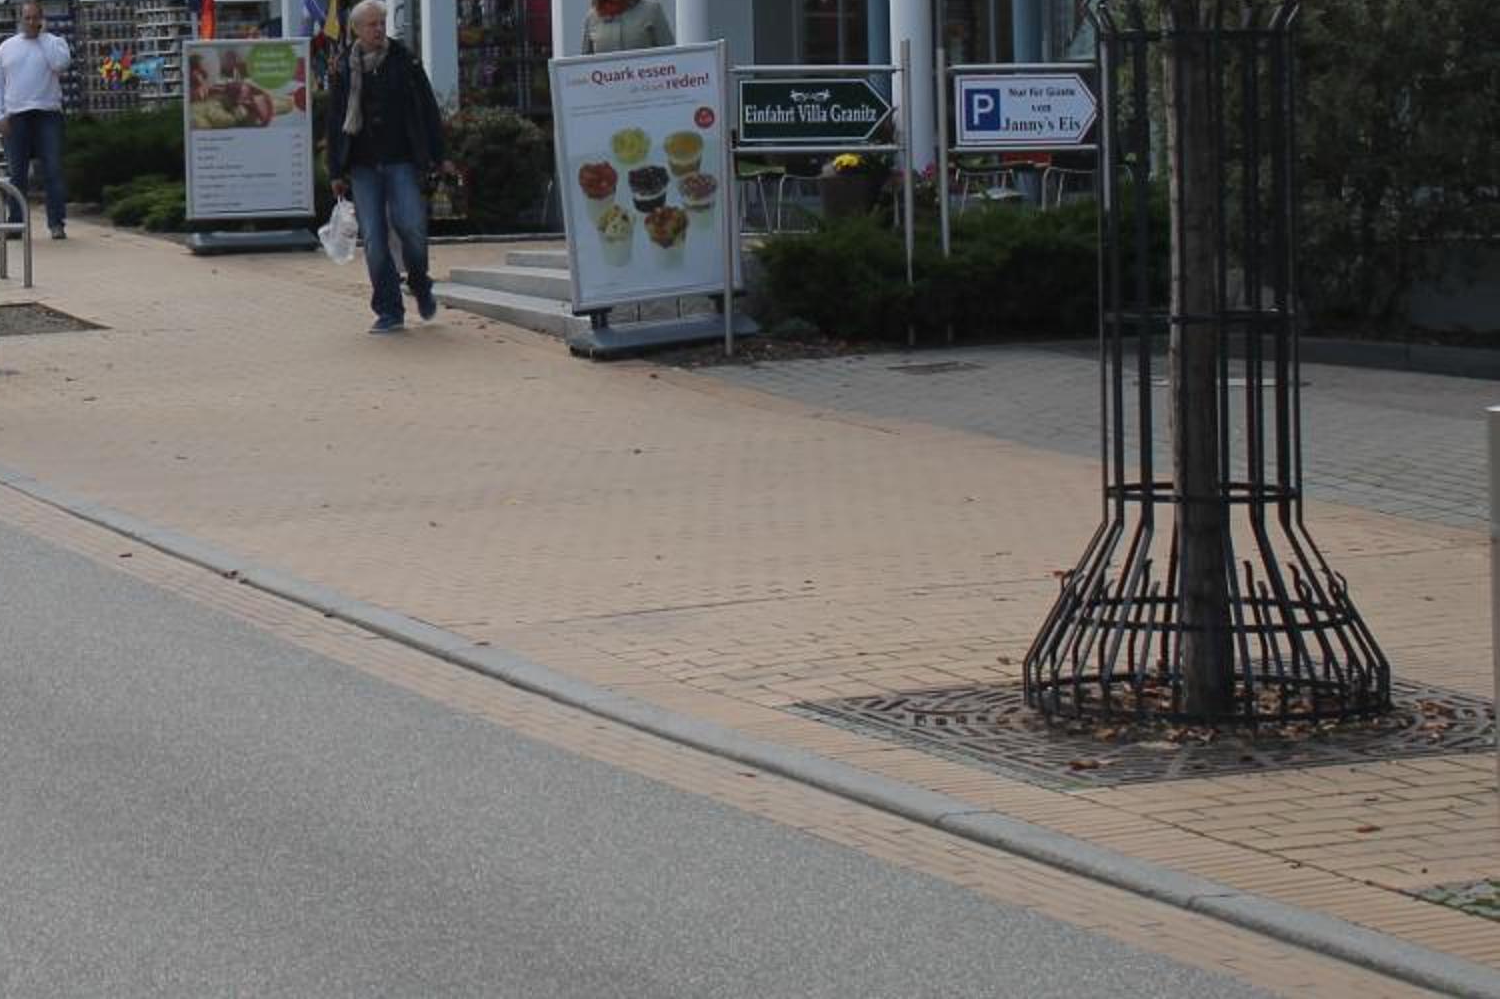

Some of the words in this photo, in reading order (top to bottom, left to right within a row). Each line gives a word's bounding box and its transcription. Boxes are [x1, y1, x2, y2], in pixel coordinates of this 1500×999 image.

[591, 67, 635, 85] Quark
[638, 64, 676, 78] essen
[666, 73, 709, 89] reden!
[744, 104, 795, 123] Einfahrt
[798, 103, 827, 122] Villa
[830, 103, 877, 122] Granitz
[973, 94, 995, 126] P
[1031, 104, 1051, 113] von
[1059, 116, 1081, 131] Eis
